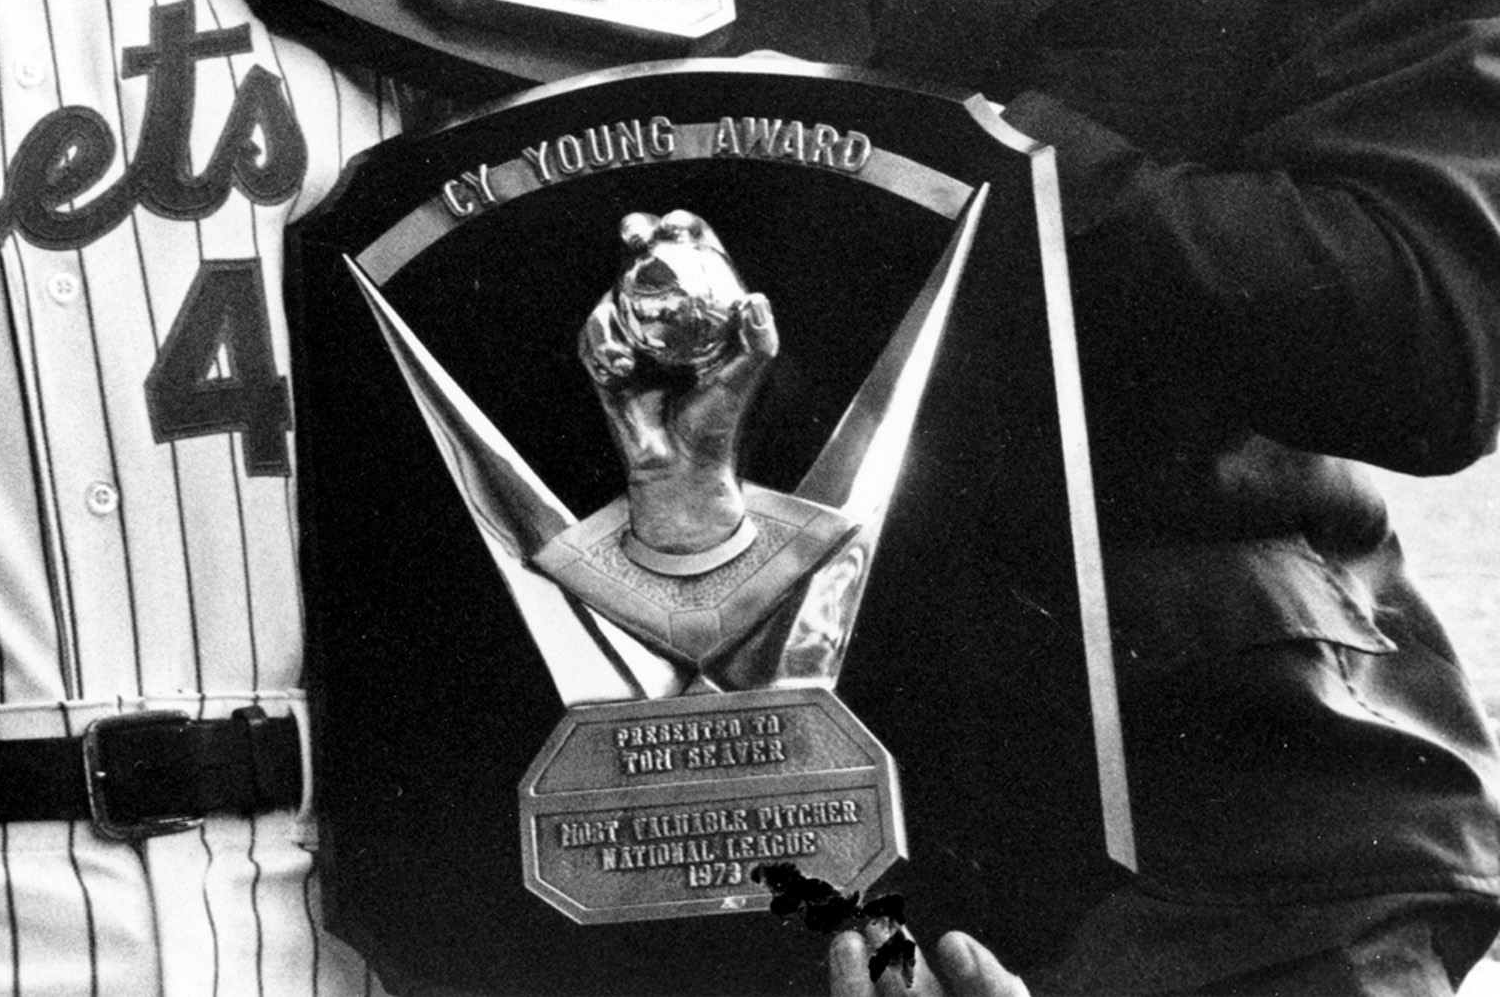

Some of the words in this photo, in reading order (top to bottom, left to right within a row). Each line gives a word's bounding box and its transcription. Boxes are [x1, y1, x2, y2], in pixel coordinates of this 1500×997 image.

[442, 163, 496, 219] CY
[521, 115, 675, 183] YOUNG
[712, 115, 872, 173] AWARD
[616, 717, 743, 748] PRESENTED
[754, 714, 781, 736] TO
[623, 748, 673, 775] TOM
[687, 739, 786, 769] SEAVER
[560, 820, 620, 848] MOST
[632, 809, 749, 842] VALUABLE
[757, 799, 859, 831] PITCHER
[601, 840, 716, 872] NATIONAL
[726, 831, 819, 860] LEAGUE
[688, 862, 743, 888] 1973
